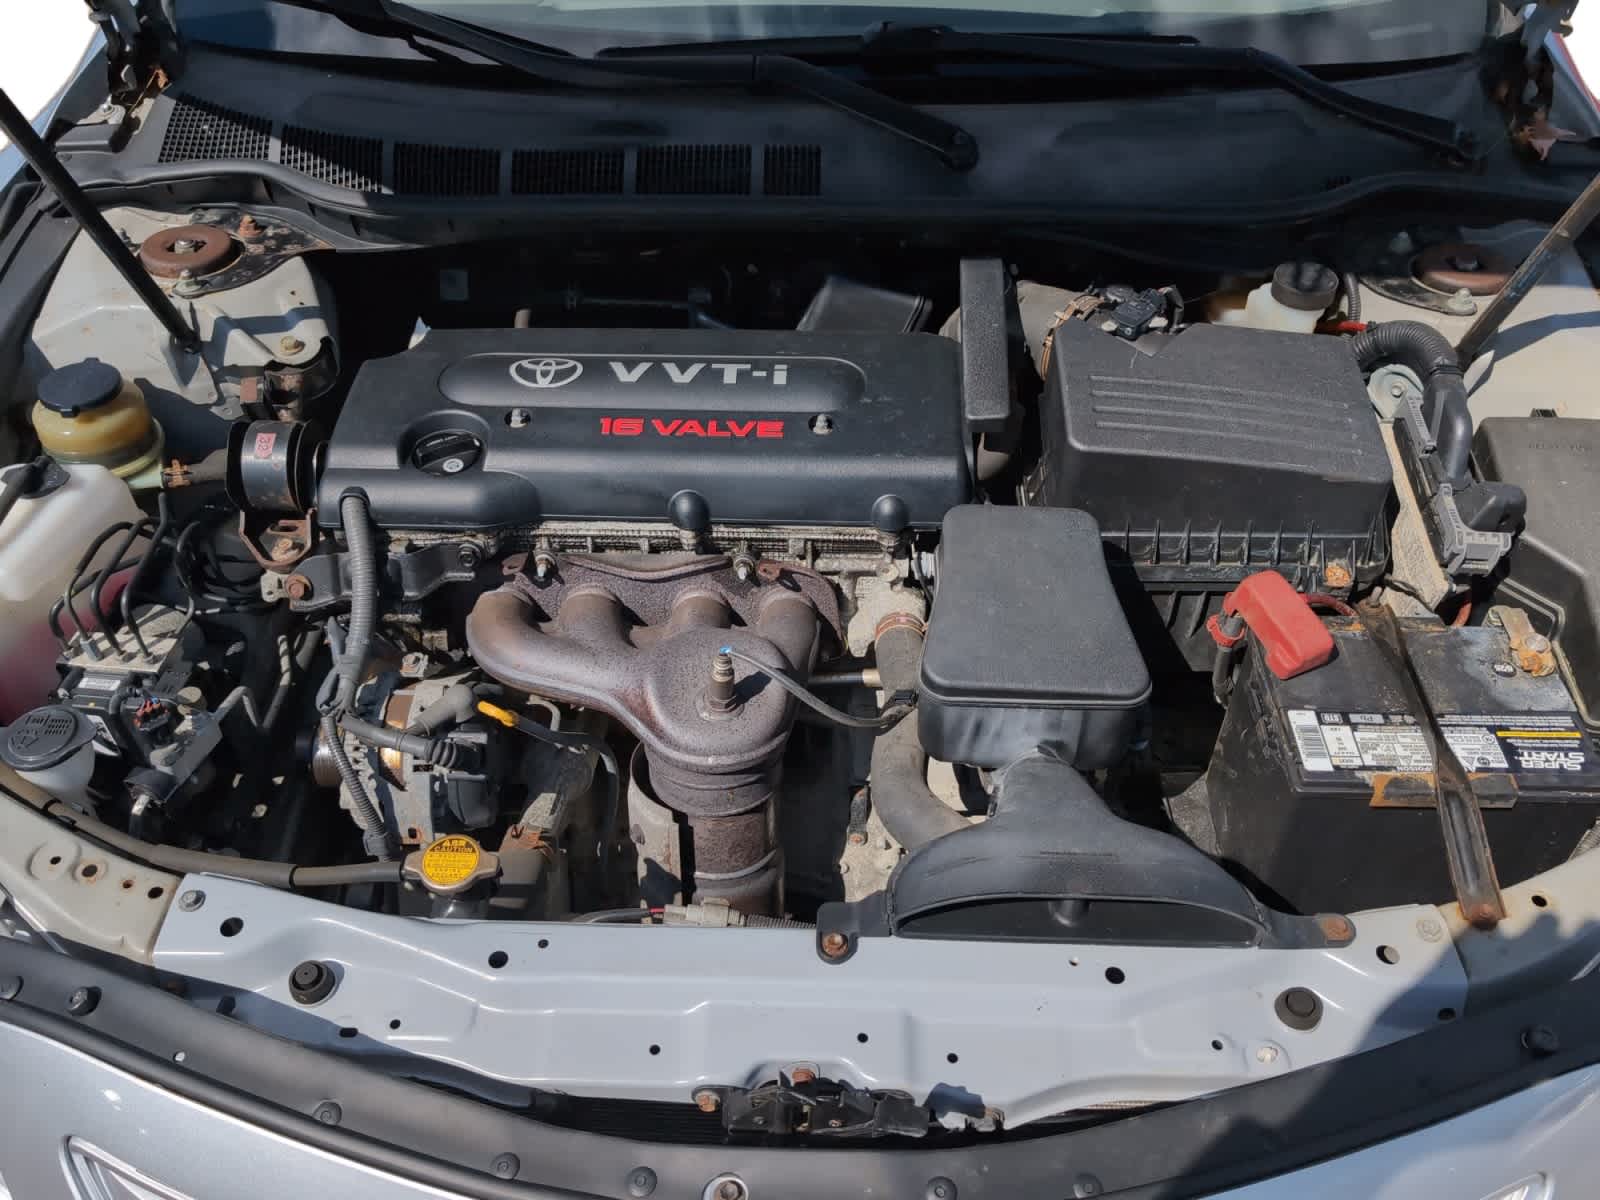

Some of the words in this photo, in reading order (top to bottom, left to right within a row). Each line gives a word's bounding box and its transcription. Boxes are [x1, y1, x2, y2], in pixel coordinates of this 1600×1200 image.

[608, 361, 788, 385] VVT-i
[600, 417, 644, 437] 16
[652, 418, 784, 438] VALVE
[1519, 751, 1585, 761] START
[1521, 760, 1582, 771] SUPER
